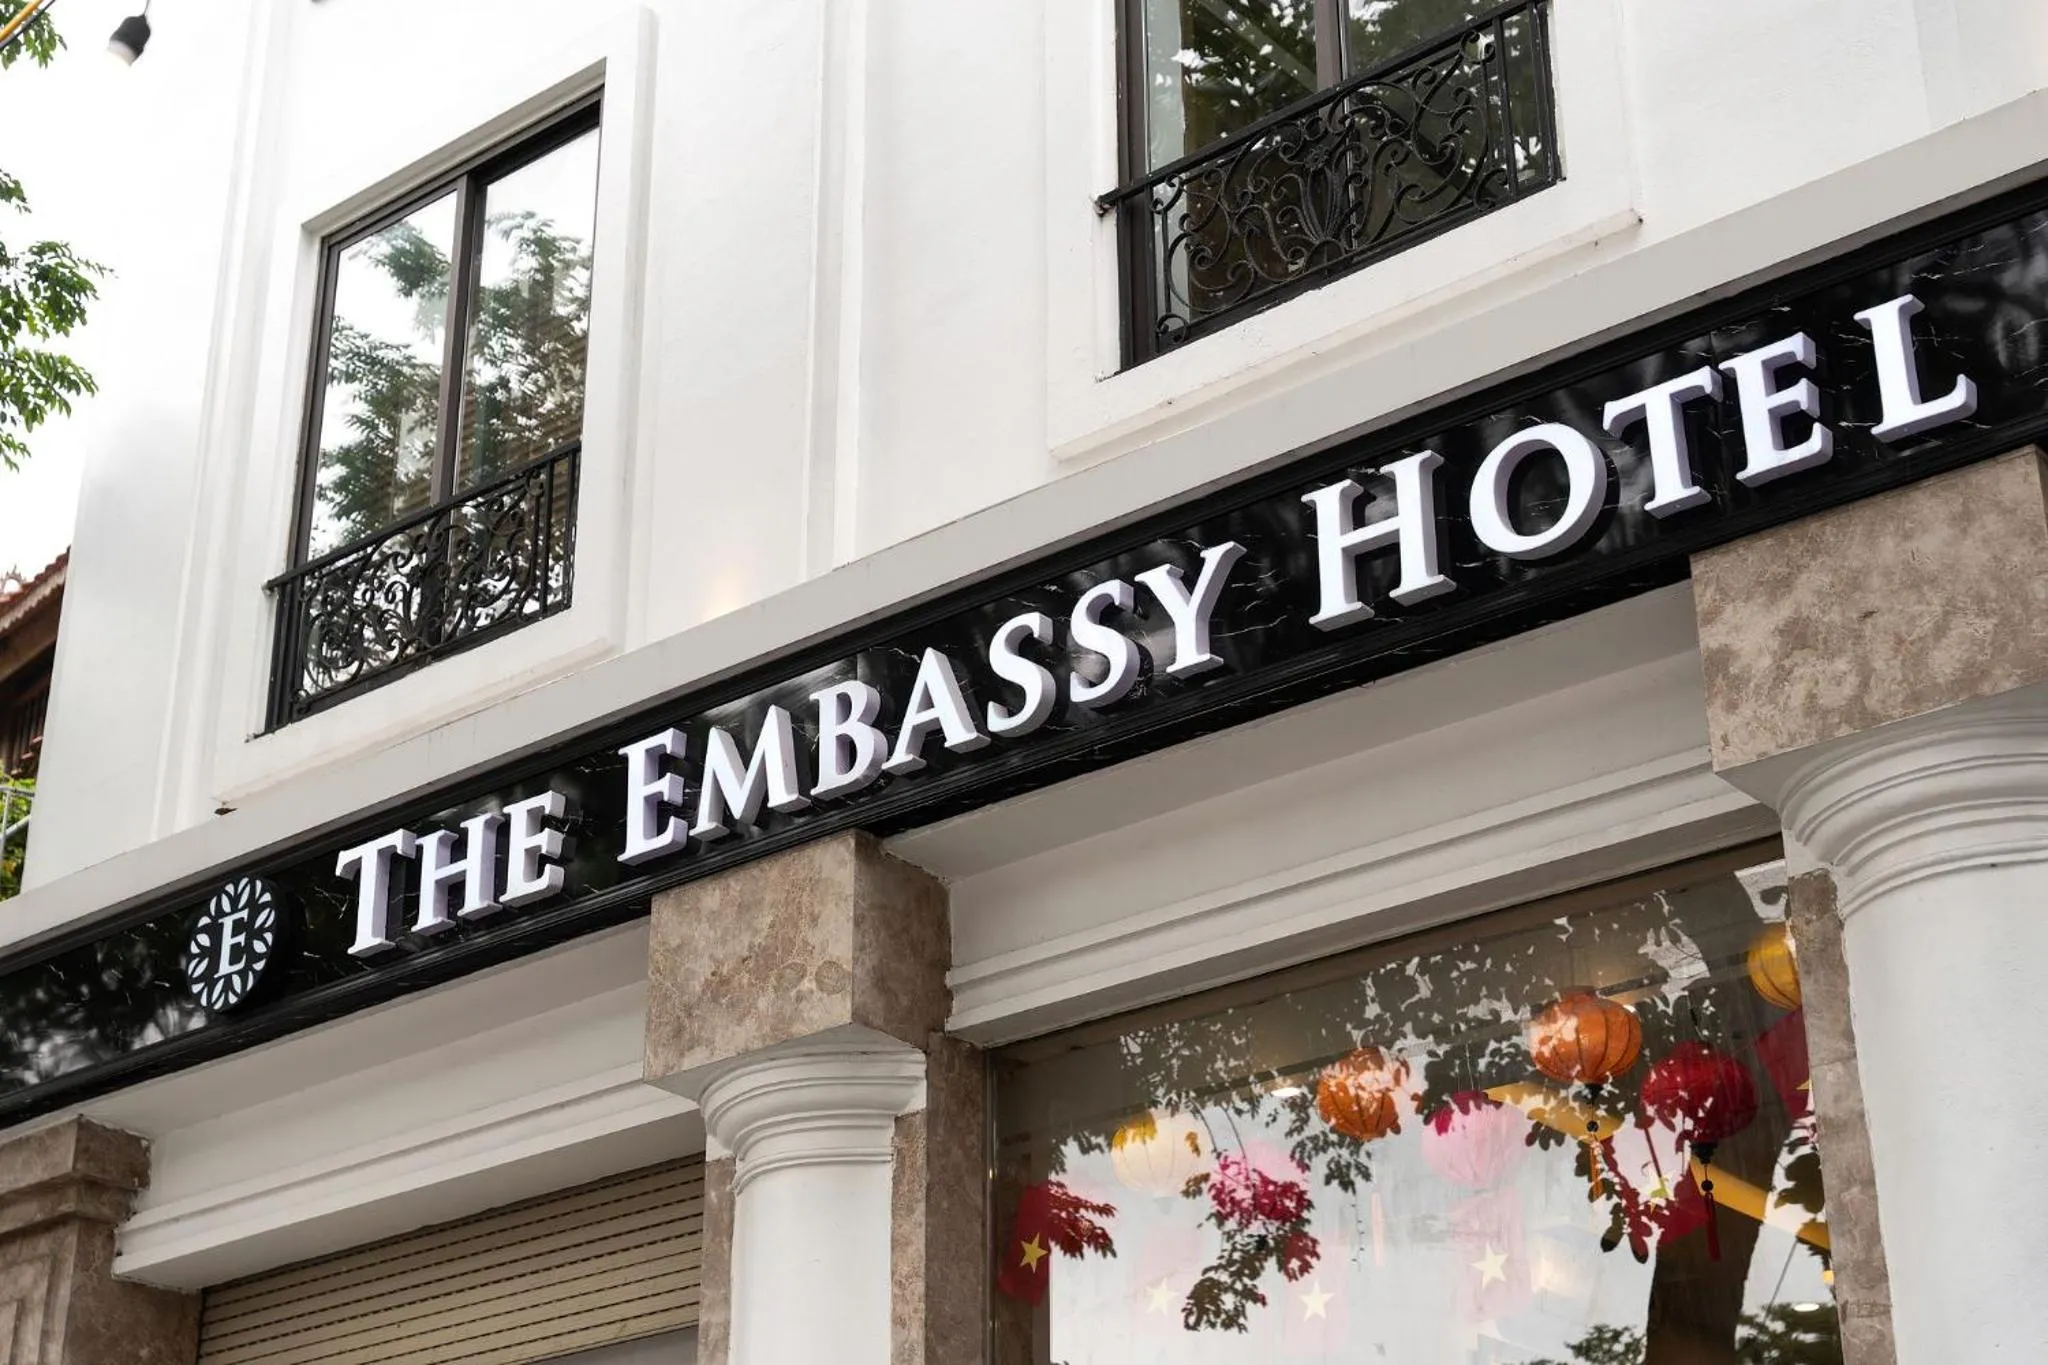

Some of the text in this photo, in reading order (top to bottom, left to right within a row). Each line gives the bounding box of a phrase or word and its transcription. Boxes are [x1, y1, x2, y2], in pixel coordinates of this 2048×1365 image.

[335, 293, 1978, 957] THE EMBASSY HOTEL
[213, 907, 250, 979] E
